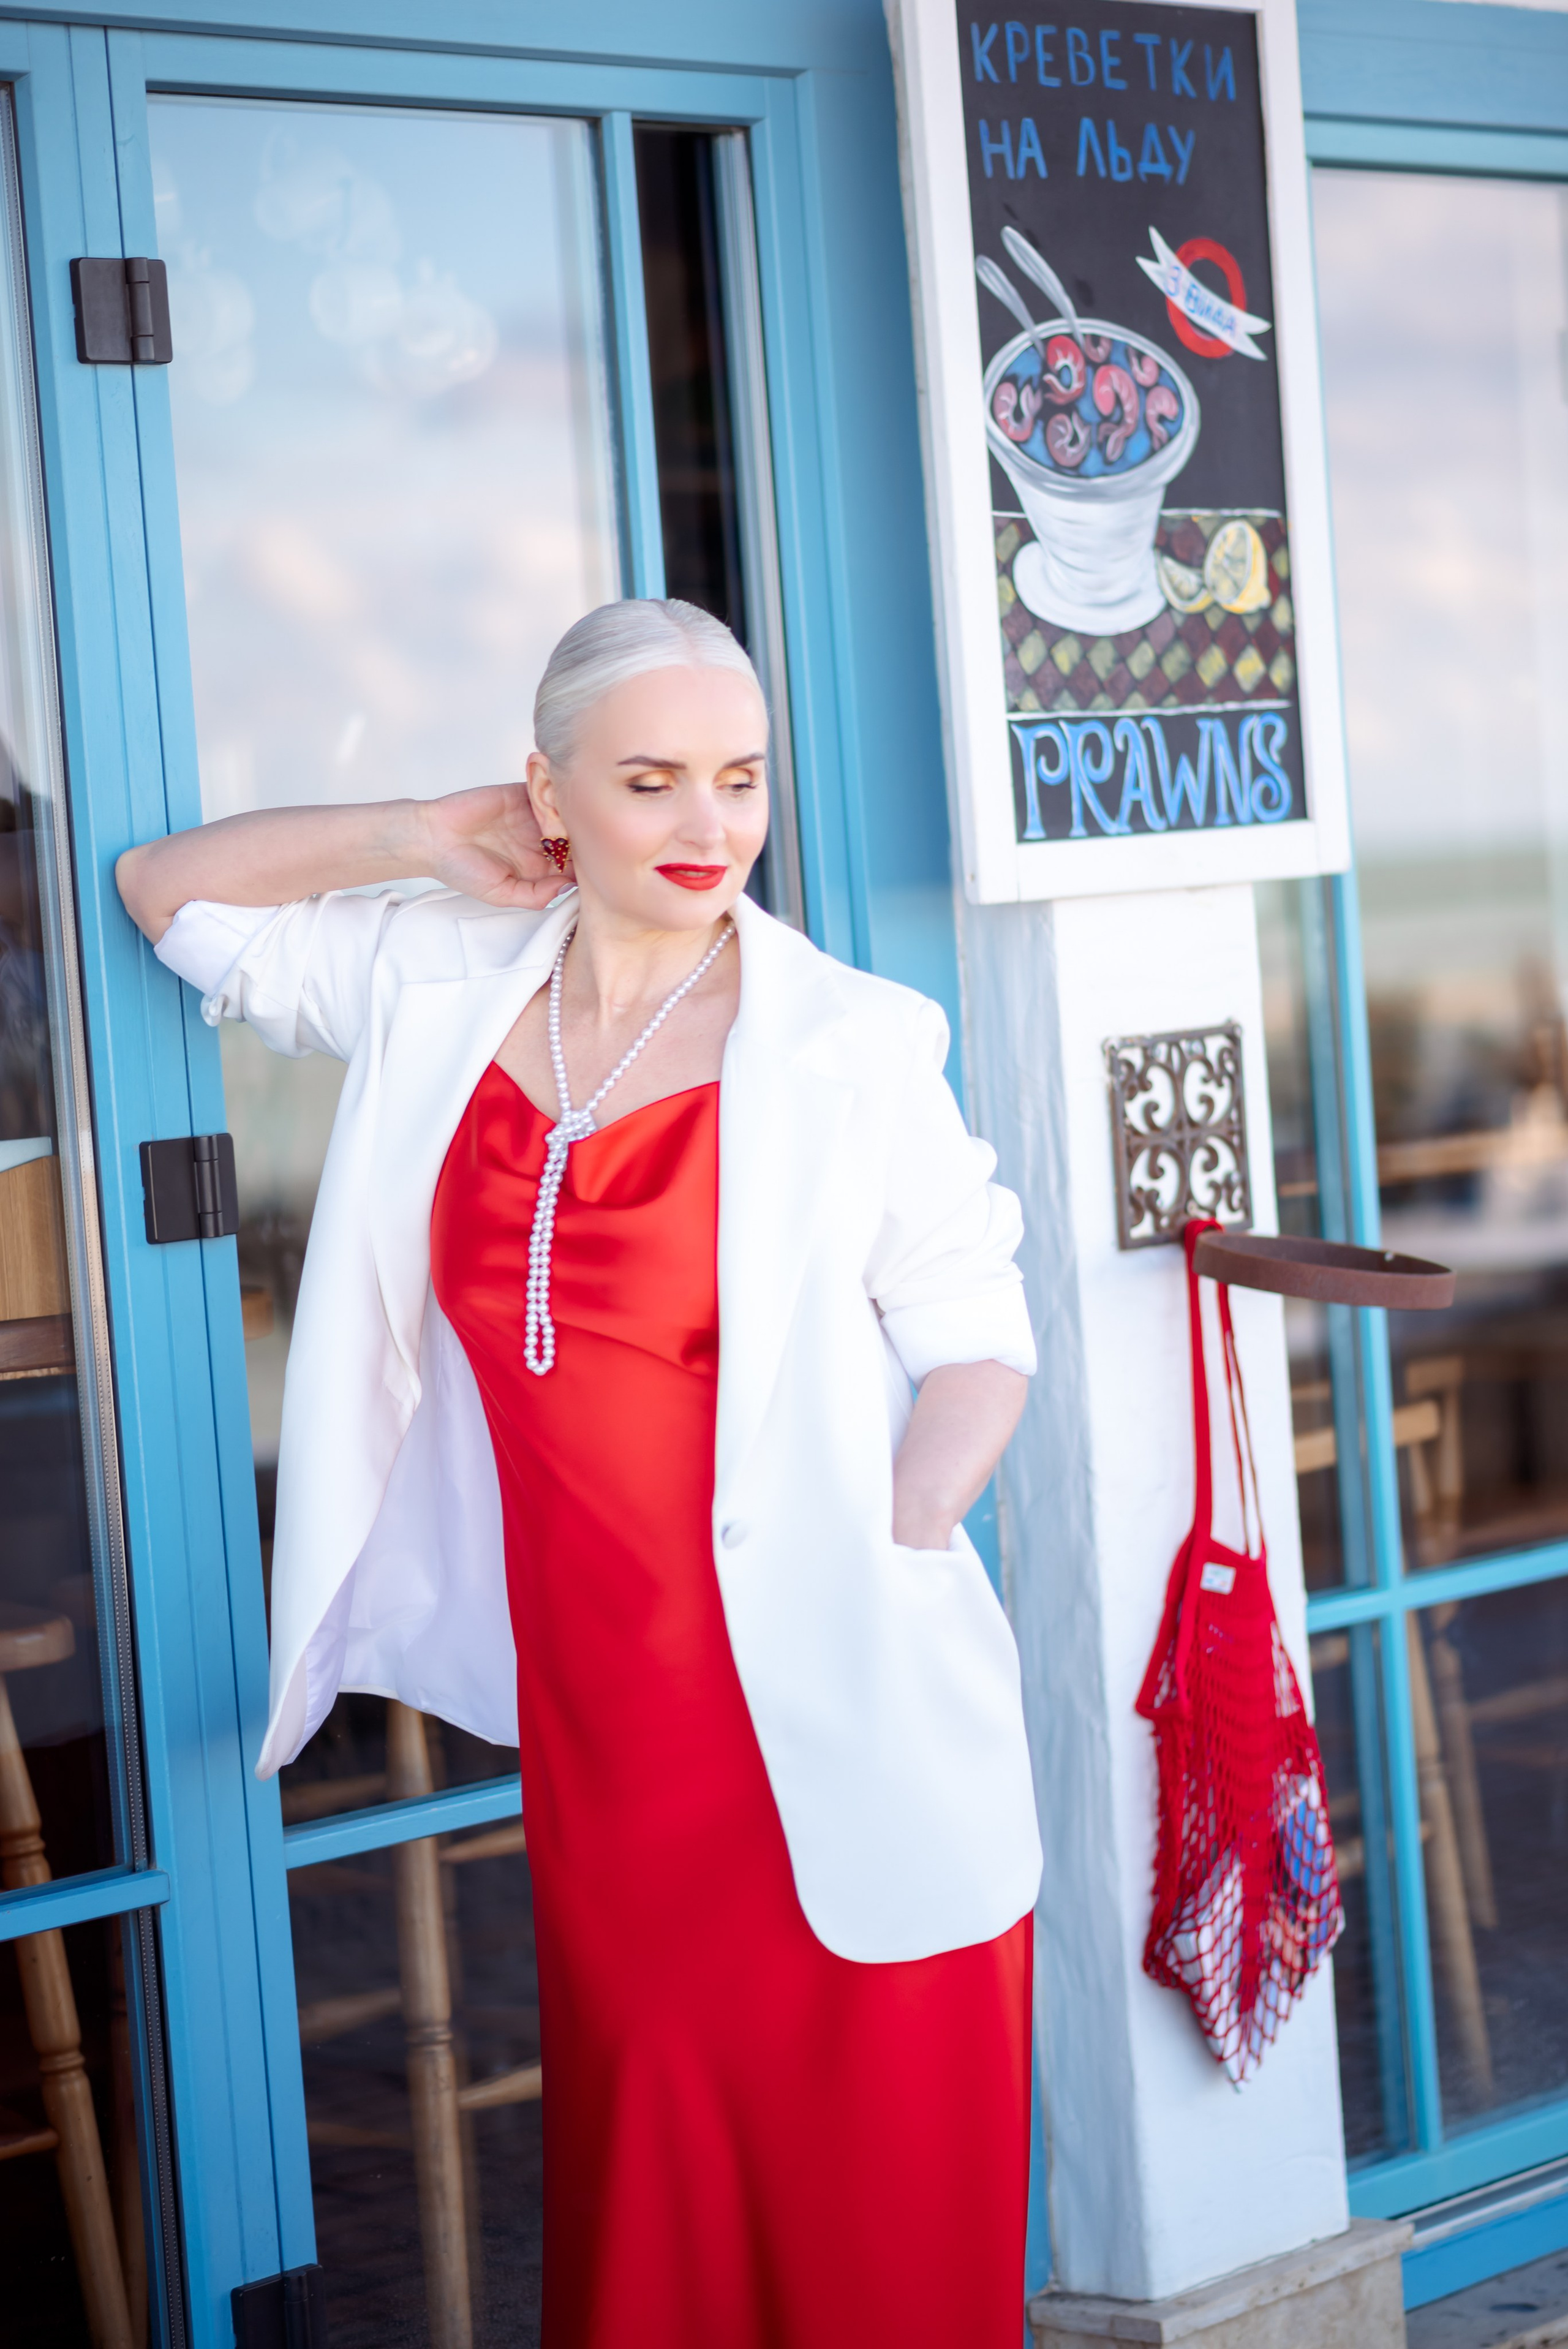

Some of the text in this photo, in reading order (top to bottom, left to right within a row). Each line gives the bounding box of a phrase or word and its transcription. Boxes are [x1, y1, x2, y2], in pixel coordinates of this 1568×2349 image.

[971, 21, 1236, 101] КРЕВЕТКИ
[979, 117, 1195, 184] НА ЛЬДУ
[1011, 711, 1292, 839] PRAWNS
